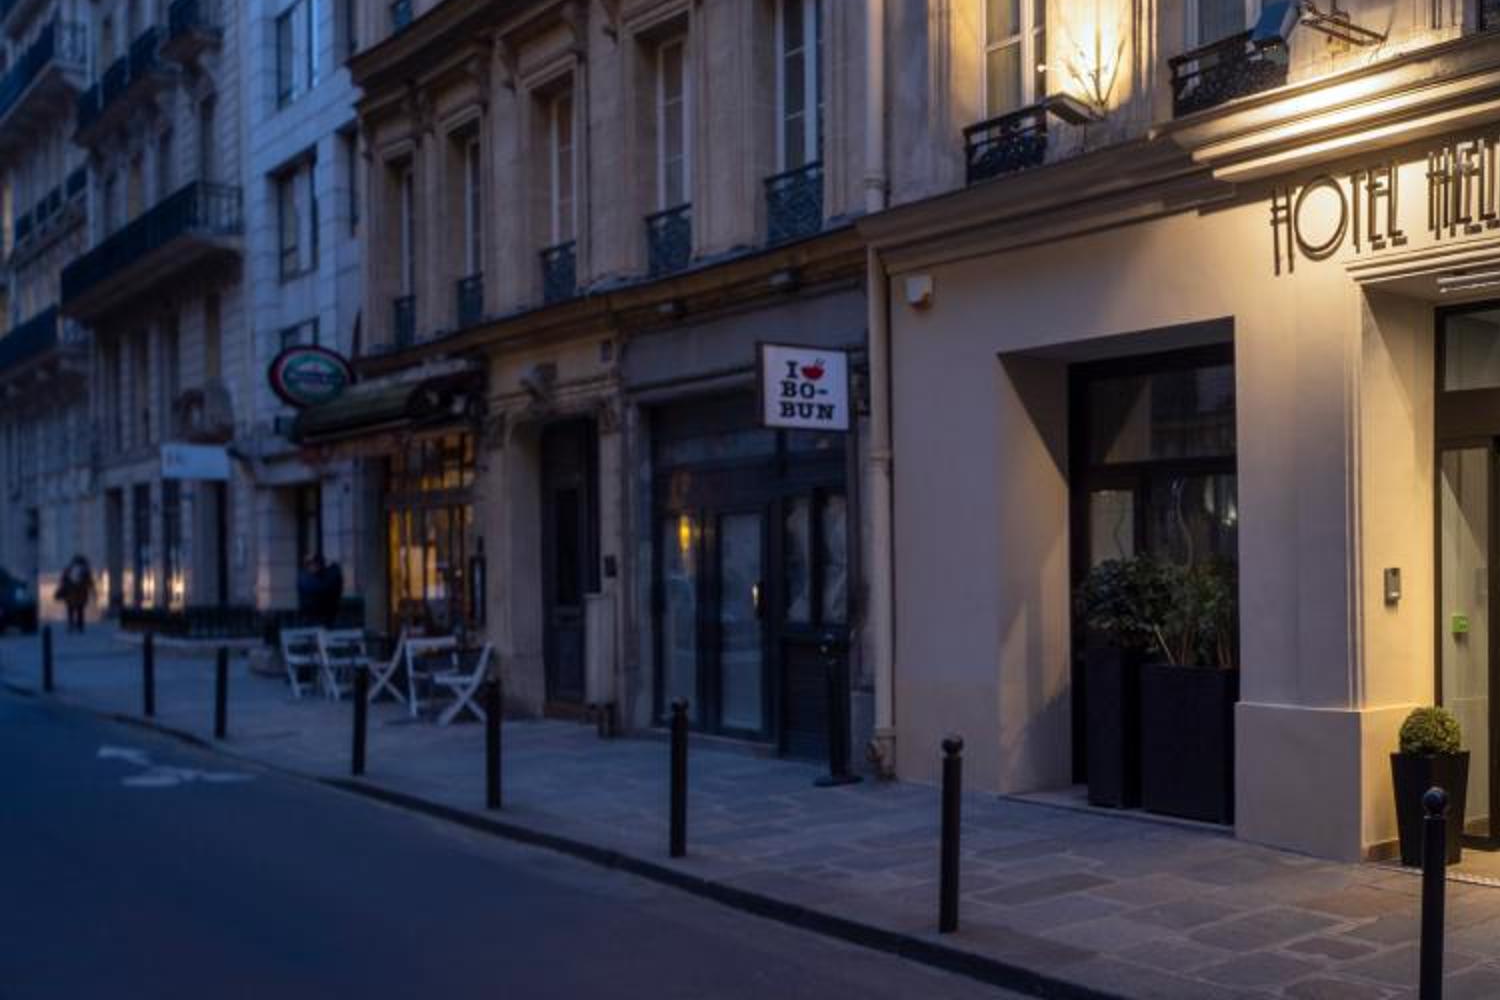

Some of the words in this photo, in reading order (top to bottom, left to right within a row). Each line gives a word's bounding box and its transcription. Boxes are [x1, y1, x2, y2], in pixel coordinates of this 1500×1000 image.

[1270, 162, 1407, 275] HOTEL
[786, 360, 798, 378] I
[781, 380, 828, 399] BO-
[781, 401, 834, 420] BUN
